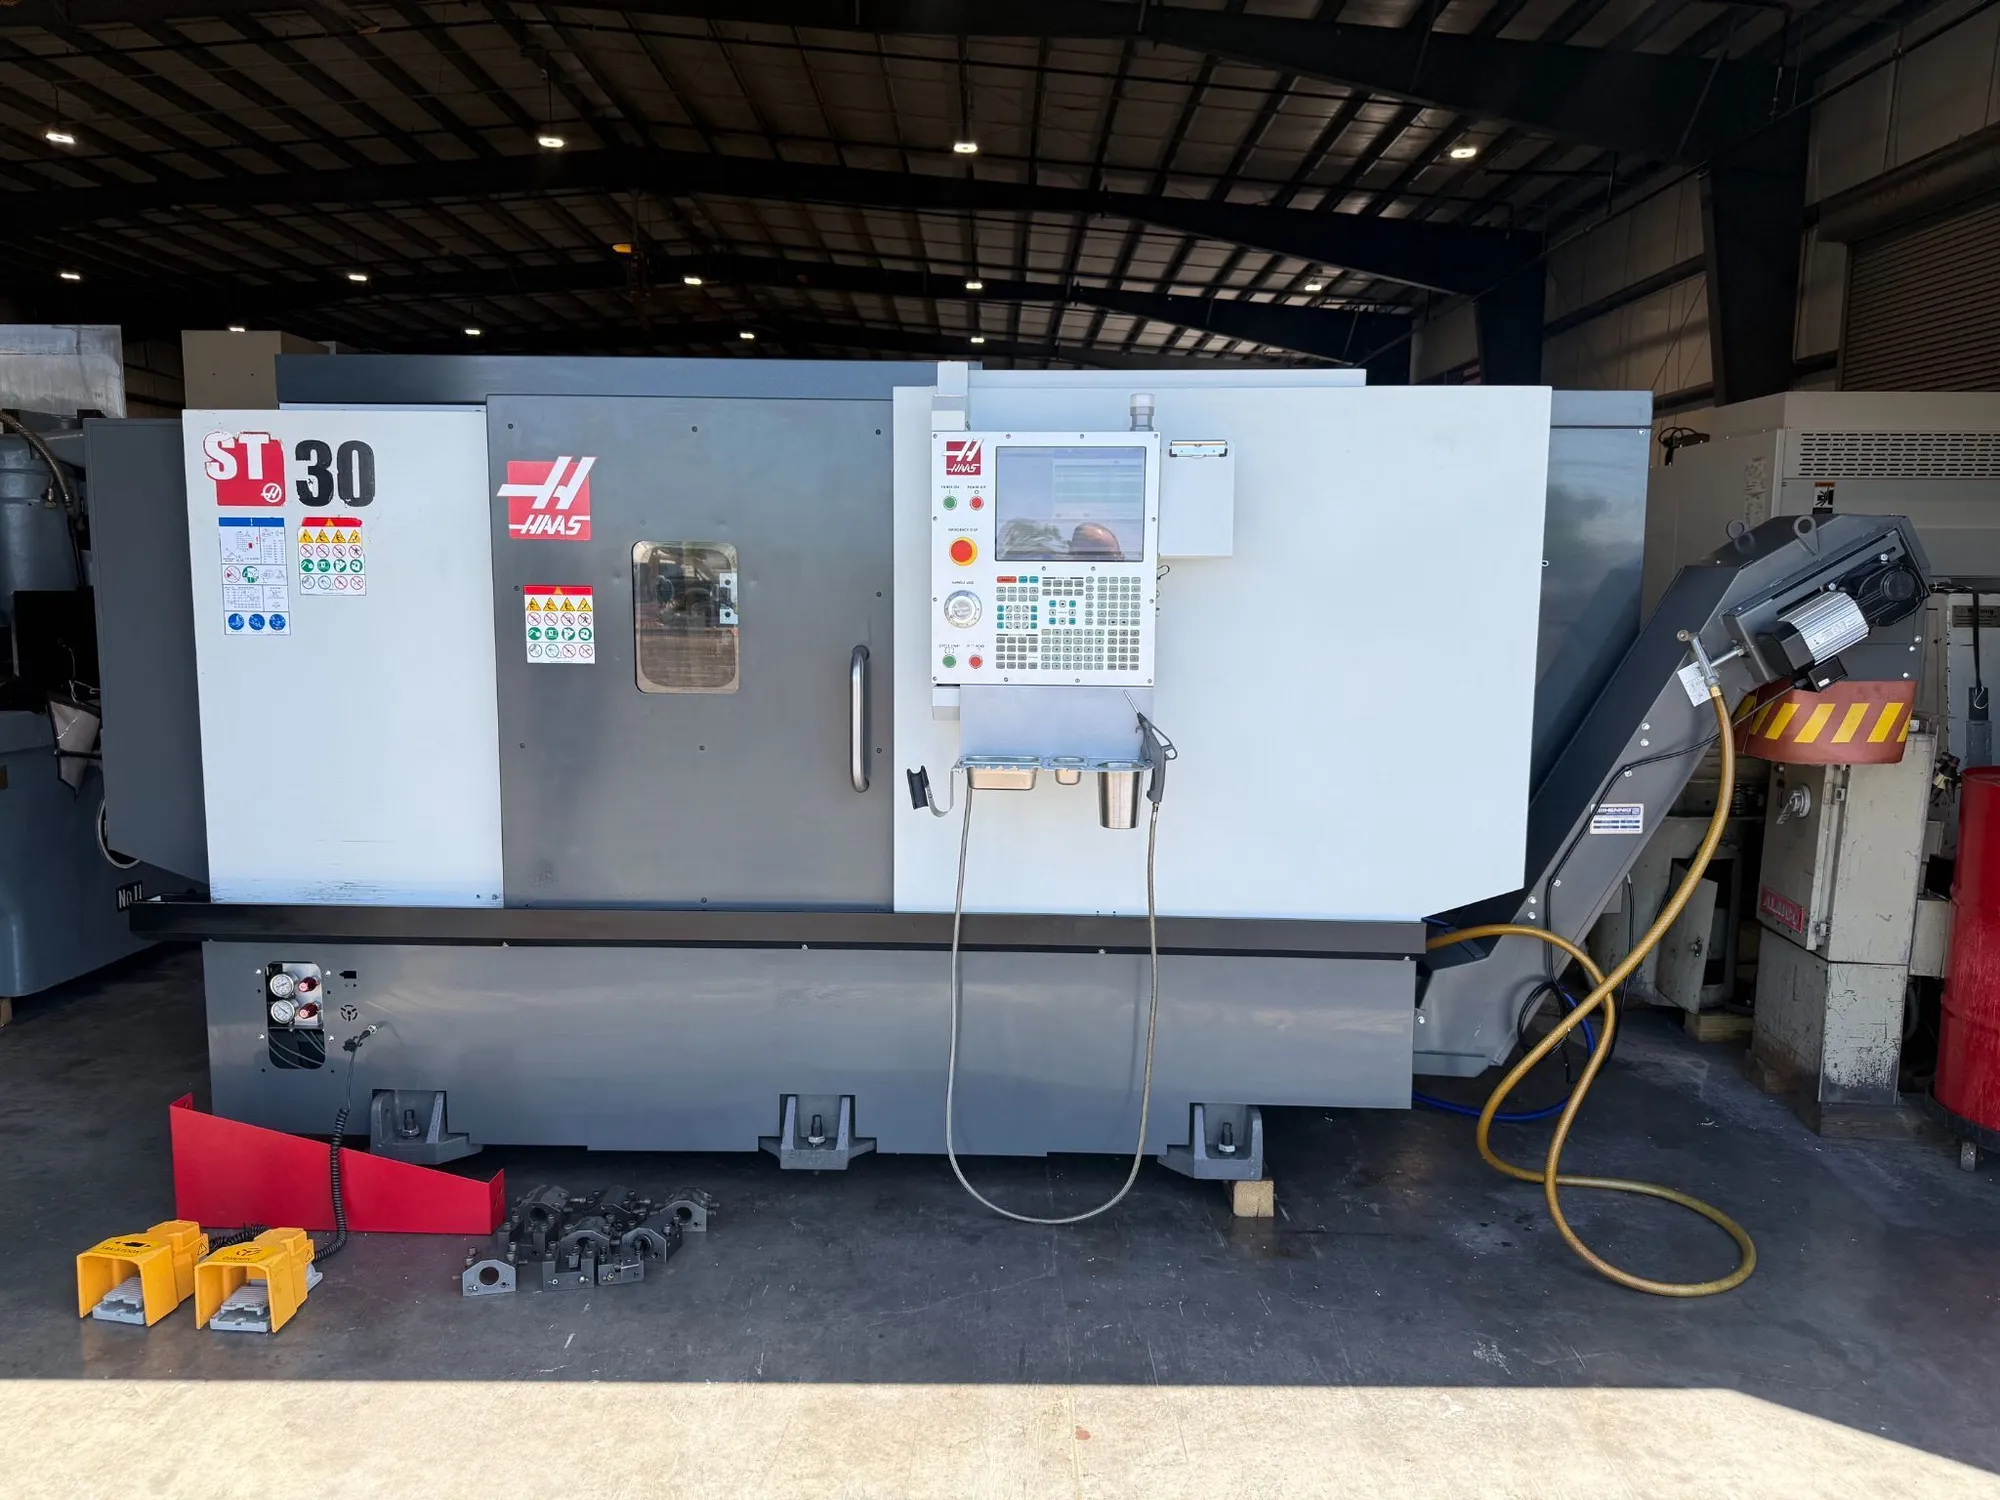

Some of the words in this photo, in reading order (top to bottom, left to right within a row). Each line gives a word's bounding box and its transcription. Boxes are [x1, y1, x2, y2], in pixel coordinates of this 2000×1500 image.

[203, 431, 270, 480] ST
[295, 439, 376, 507] 30
[947, 464, 980, 473] HAAS
[509, 514, 590, 535] HAAS
